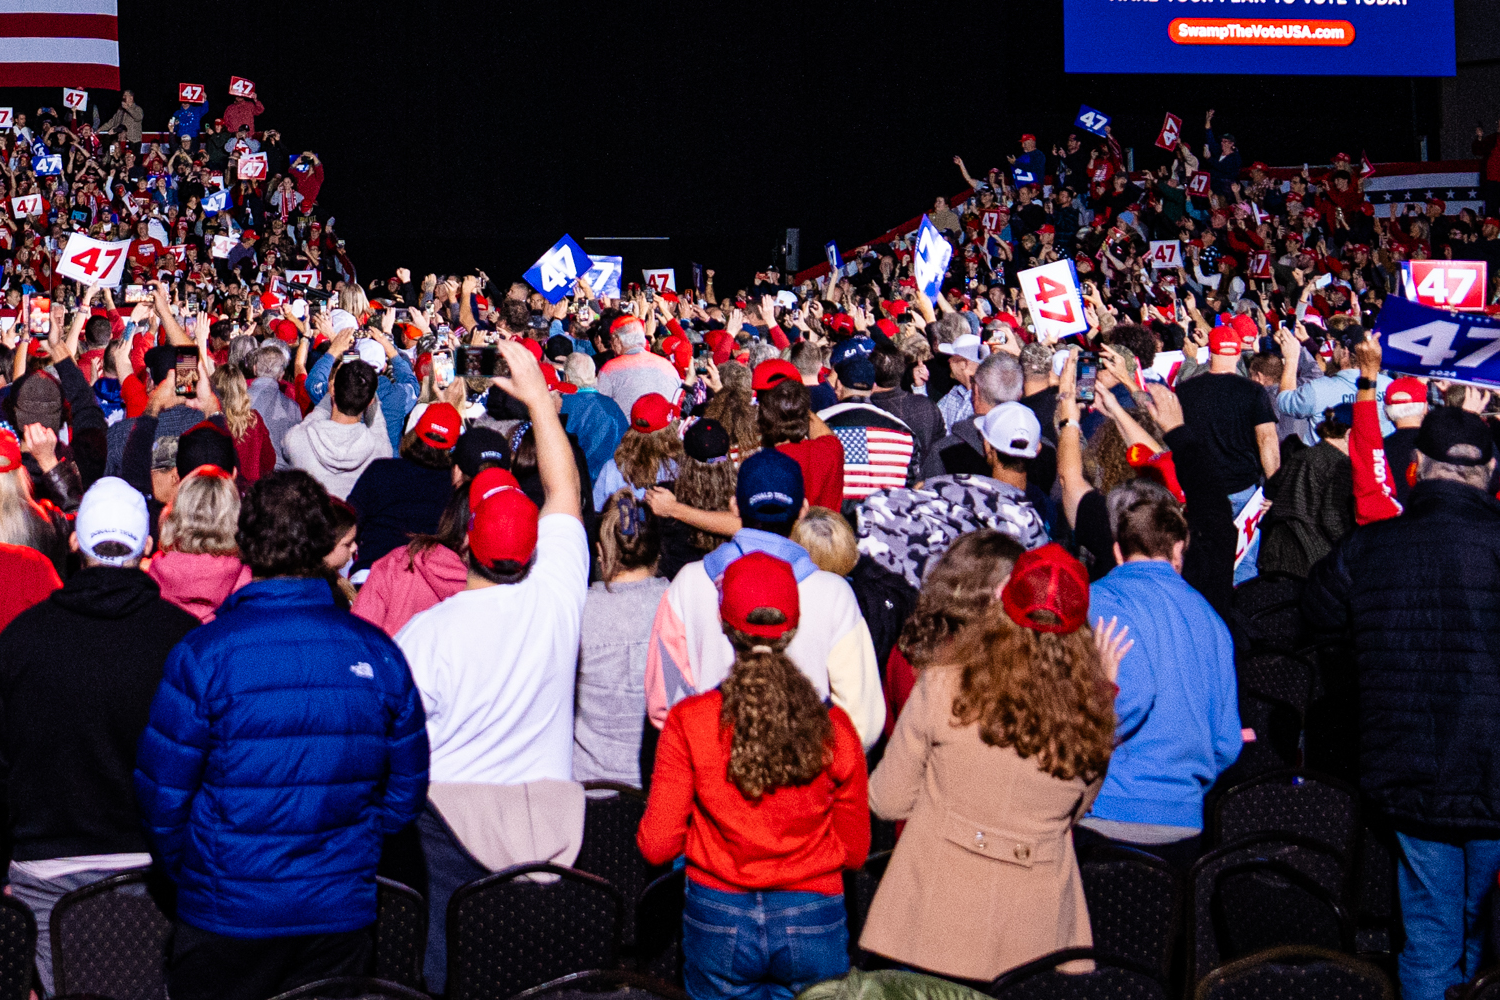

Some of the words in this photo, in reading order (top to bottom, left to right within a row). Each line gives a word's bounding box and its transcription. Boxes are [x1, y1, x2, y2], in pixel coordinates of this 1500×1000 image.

[1178, 22, 1345, 42] SwampTheVoteUSA.com
[182, 86, 202, 100] 47
[233, 80, 253, 94] 47
[65, 92, 85, 107] 47
[1080, 111, 1108, 131] 47
[1162, 117, 1179, 146] 47
[36, 158, 59, 171] 47
[241, 162, 264, 177] 47
[1190, 174, 1207, 192] 47
[17, 197, 38, 213] 47
[206, 192, 227, 211] 47
[982, 211, 998, 230] 47
[70, 247, 123, 279] 47
[1155, 244, 1176, 263] 47
[540, 244, 577, 292] 47
[649, 274, 670, 291] 47
[1417, 268, 1477, 304] 47
[1034, 274, 1076, 324] 47
[1387, 320, 1500, 369] 47
[1429, 369, 1457, 378] 2024
